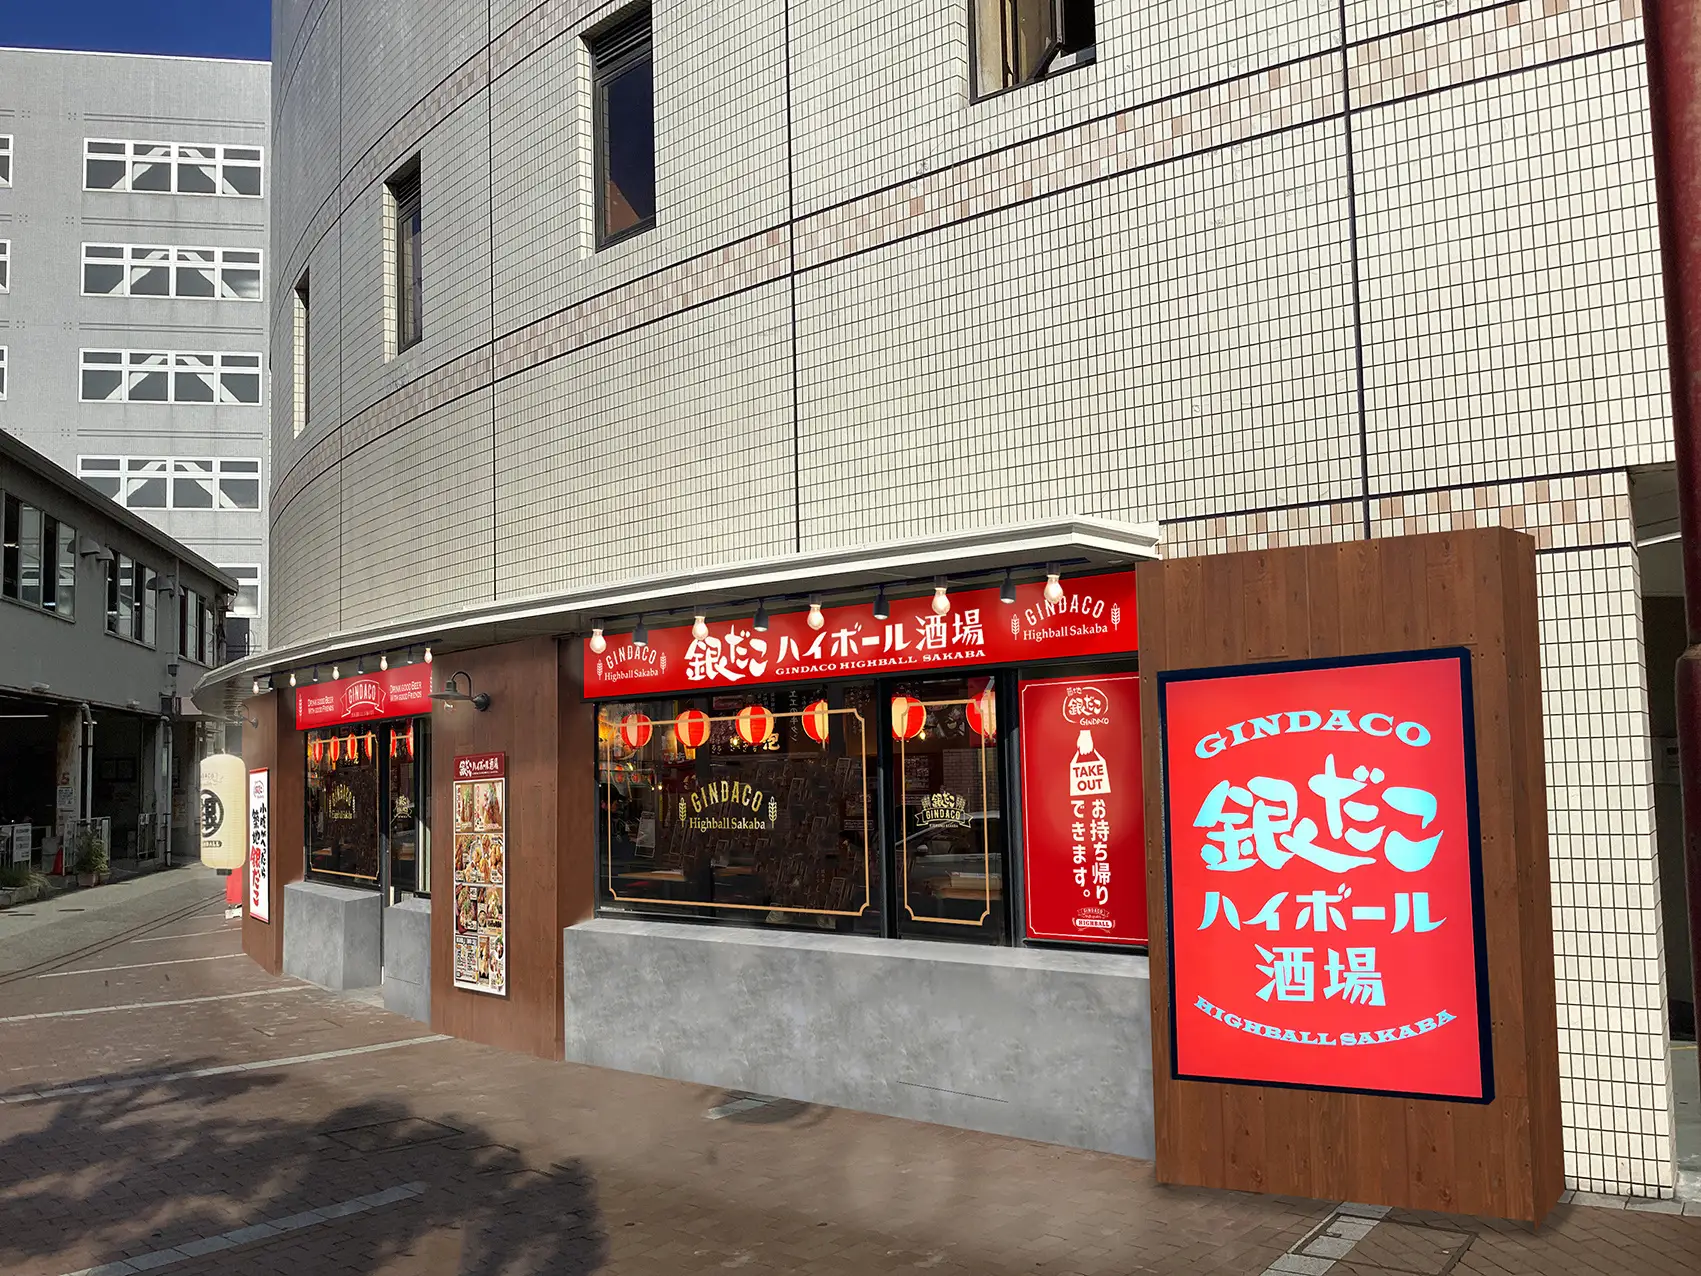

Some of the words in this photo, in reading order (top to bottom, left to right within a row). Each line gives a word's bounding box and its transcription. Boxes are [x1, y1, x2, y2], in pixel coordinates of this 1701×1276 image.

[1024, 594, 1105, 626] GINDACO
[1023, 626, 1068, 642] Highball
[1070, 623, 1108, 636] Sakaba
[605, 645, 657, 670] GINDACO
[775, 663, 837, 676] GINDACO
[840, 655, 917, 669] HIGHBALL
[922, 649, 986, 663] SAKABA
[604, 670, 634, 682] Highball
[634, 667, 658, 679] Sakaba
[348, 685, 376, 704] GINDACO
[1068, 694, 1101, 716] 銀だこ
[1080, 717, 1110, 726] GINDACO
[1194, 709, 1432, 760] GINDACO
[1073, 764, 1104, 779] TAKE
[691, 780, 763, 813] GINDACO
[1077, 779, 1103, 792] OUT
[689, 817, 730, 833] Highball
[731, 817, 766, 830] Sakaba
[925, 809, 961, 820] GINDACO
[1193, 753, 1444, 874] 銀だこ
[1070, 800, 1091, 897] できます。
[1089, 798, 1111, 905] お持ち帰り
[1197, 883, 1447, 934] ハイボール
[1255, 943, 1386, 1007] 酒場
[1193, 995, 1337, 1047] HIGHBALL
[1341, 1009, 1458, 1047] SAKABA
